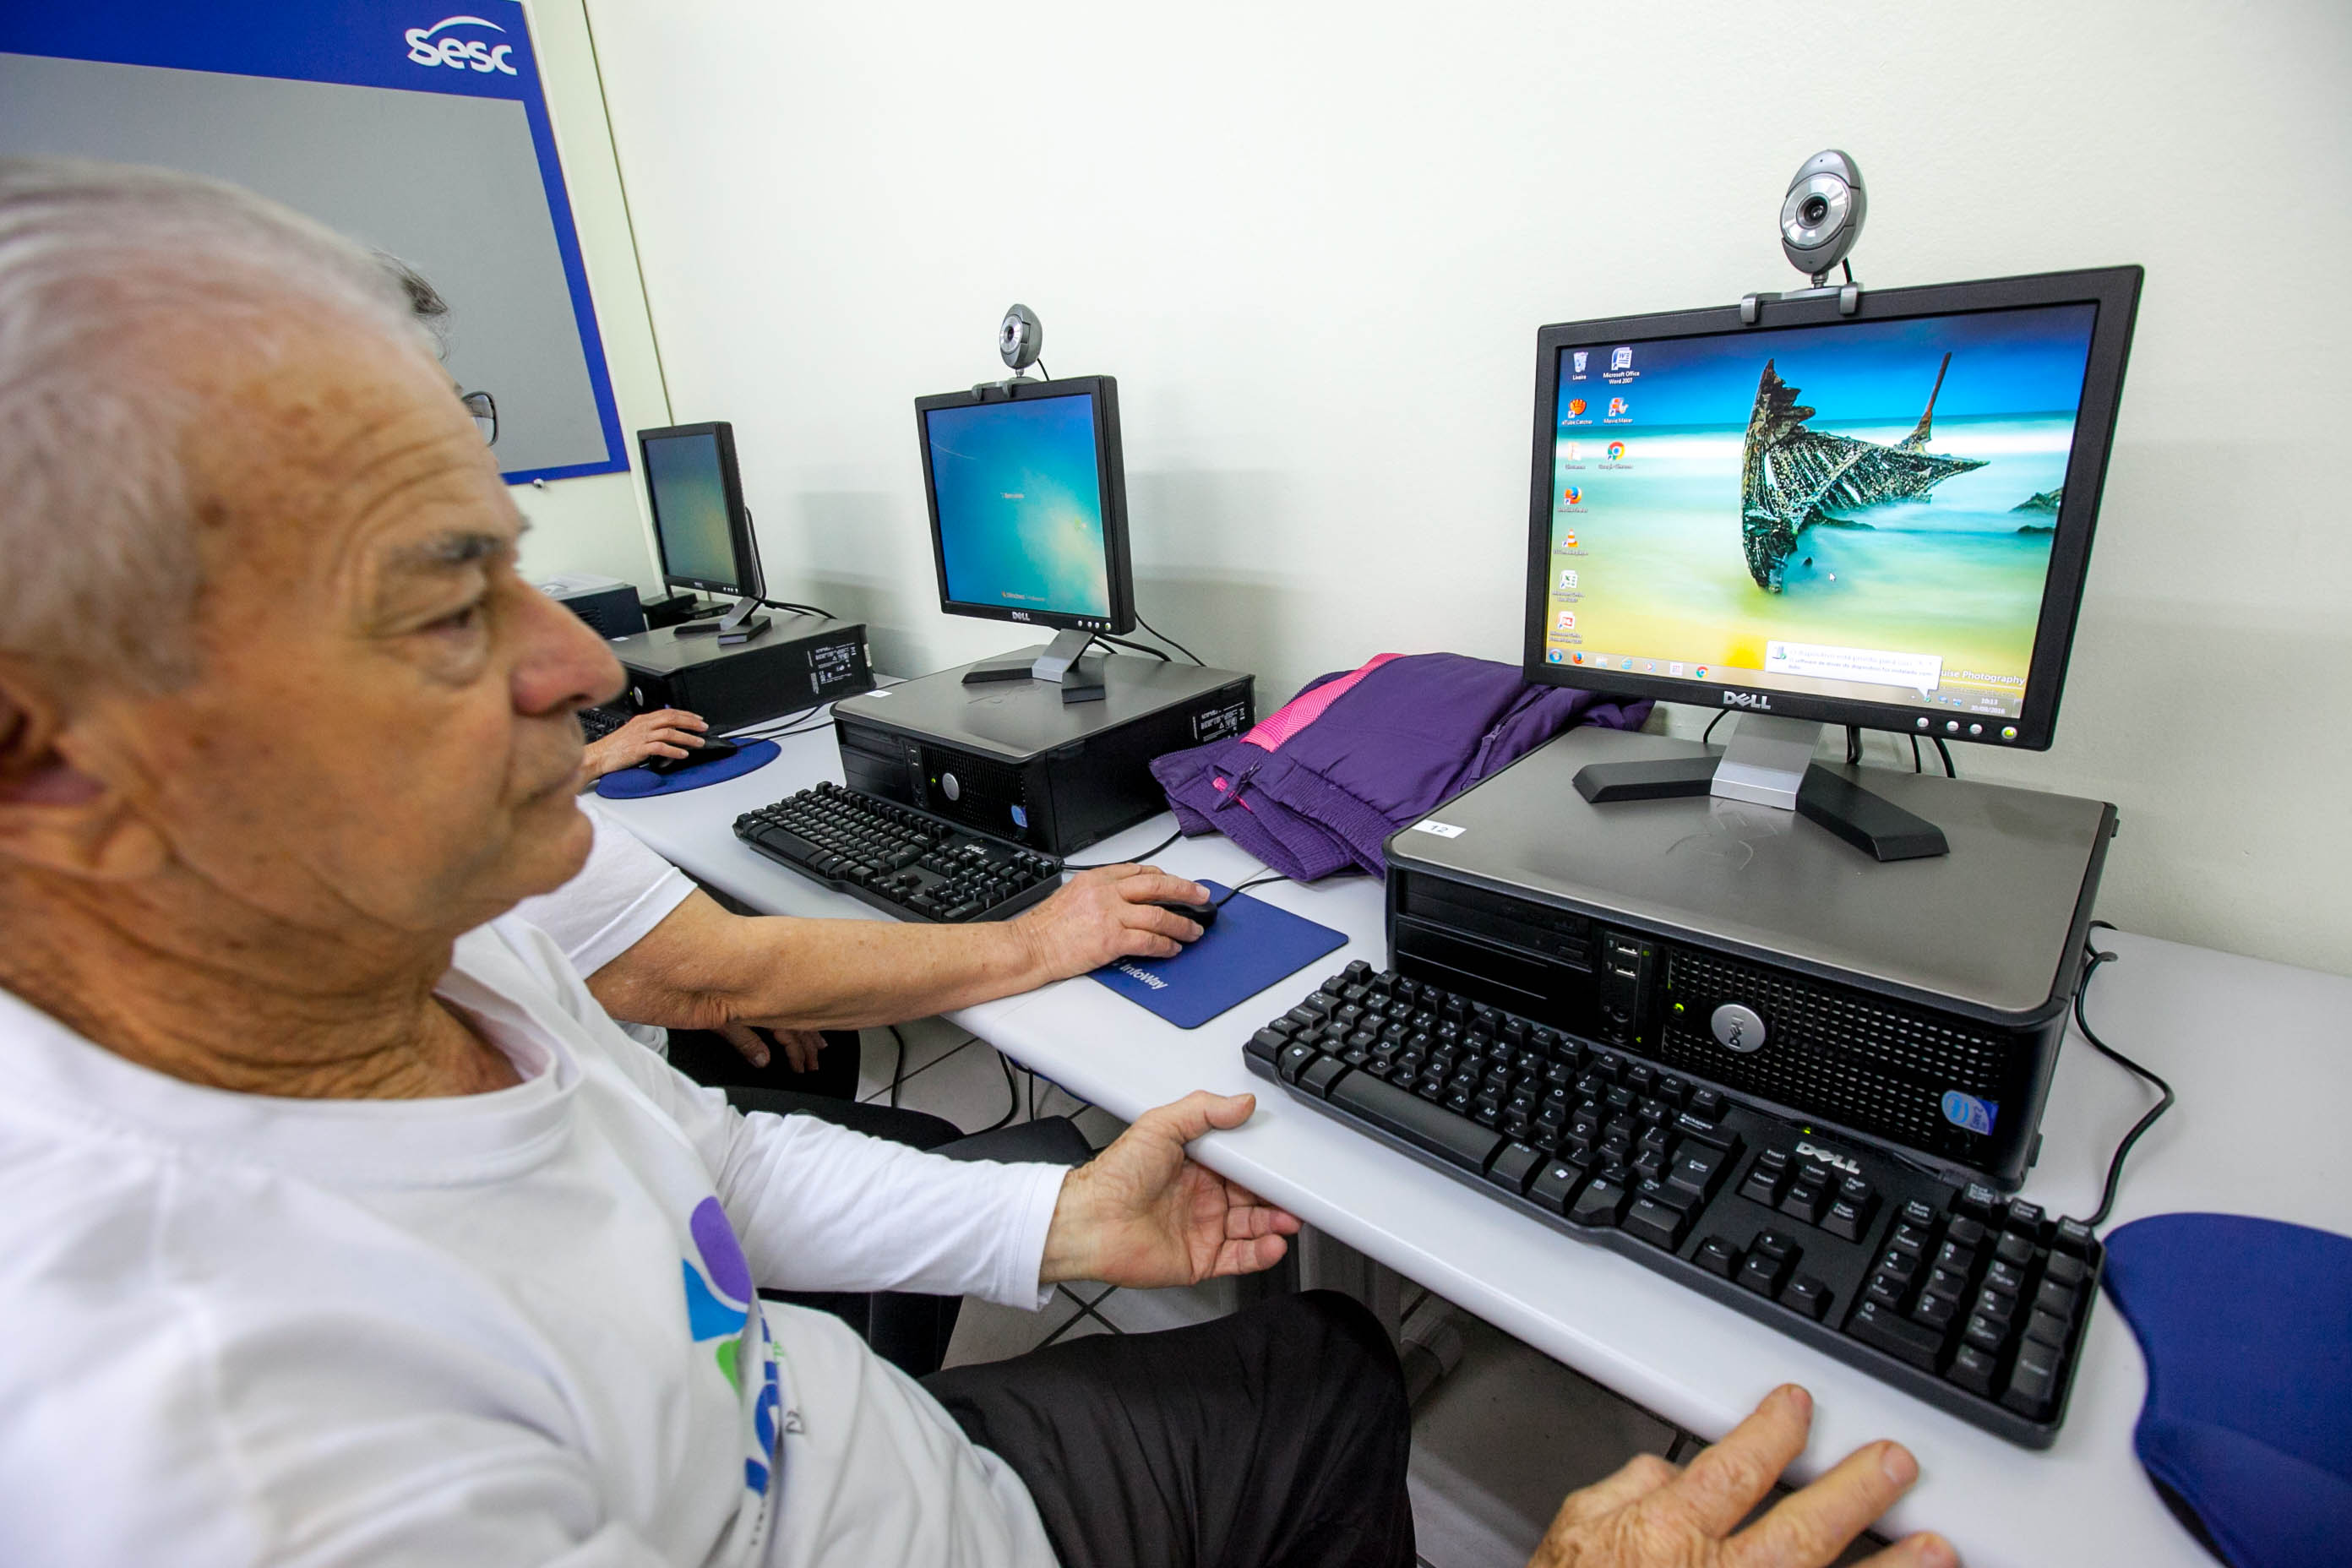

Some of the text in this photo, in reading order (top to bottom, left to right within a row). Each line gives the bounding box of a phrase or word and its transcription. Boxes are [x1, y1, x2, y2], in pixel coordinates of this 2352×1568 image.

[1941, 668, 2026, 686] uise Photography
[1723, 690, 1772, 710] DELL
[1119, 963, 1168, 989] InfoWay
[1729, 1015, 1745, 1049] DELL
[1795, 1141, 1860, 1174] DELL
